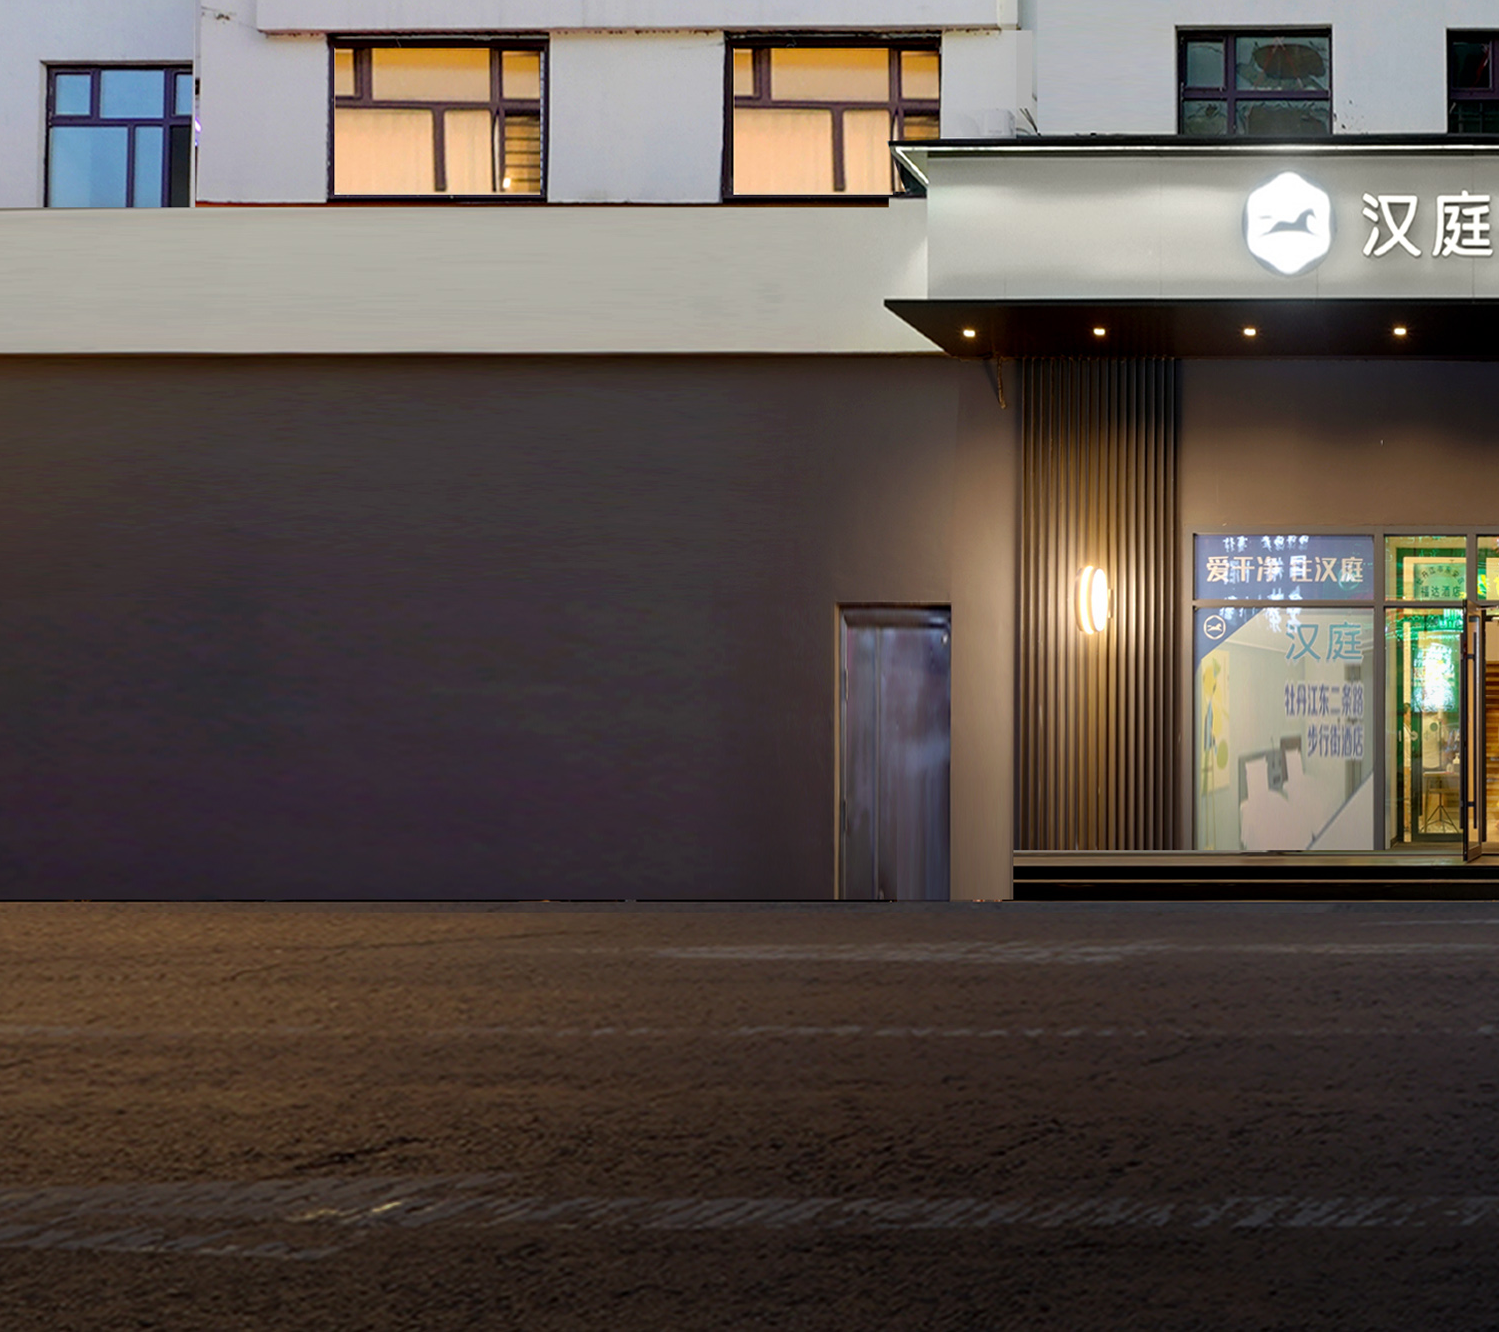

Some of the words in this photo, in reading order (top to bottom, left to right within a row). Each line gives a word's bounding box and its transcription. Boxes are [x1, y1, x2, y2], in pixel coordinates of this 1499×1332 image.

[1206, 555, 1280, 583] 爱干净
[1285, 621, 1362, 661] 汉庭
[1284, 683, 1364, 717] 牡丹江东二条路
[1307, 723, 1363, 758] 步行街酒店
